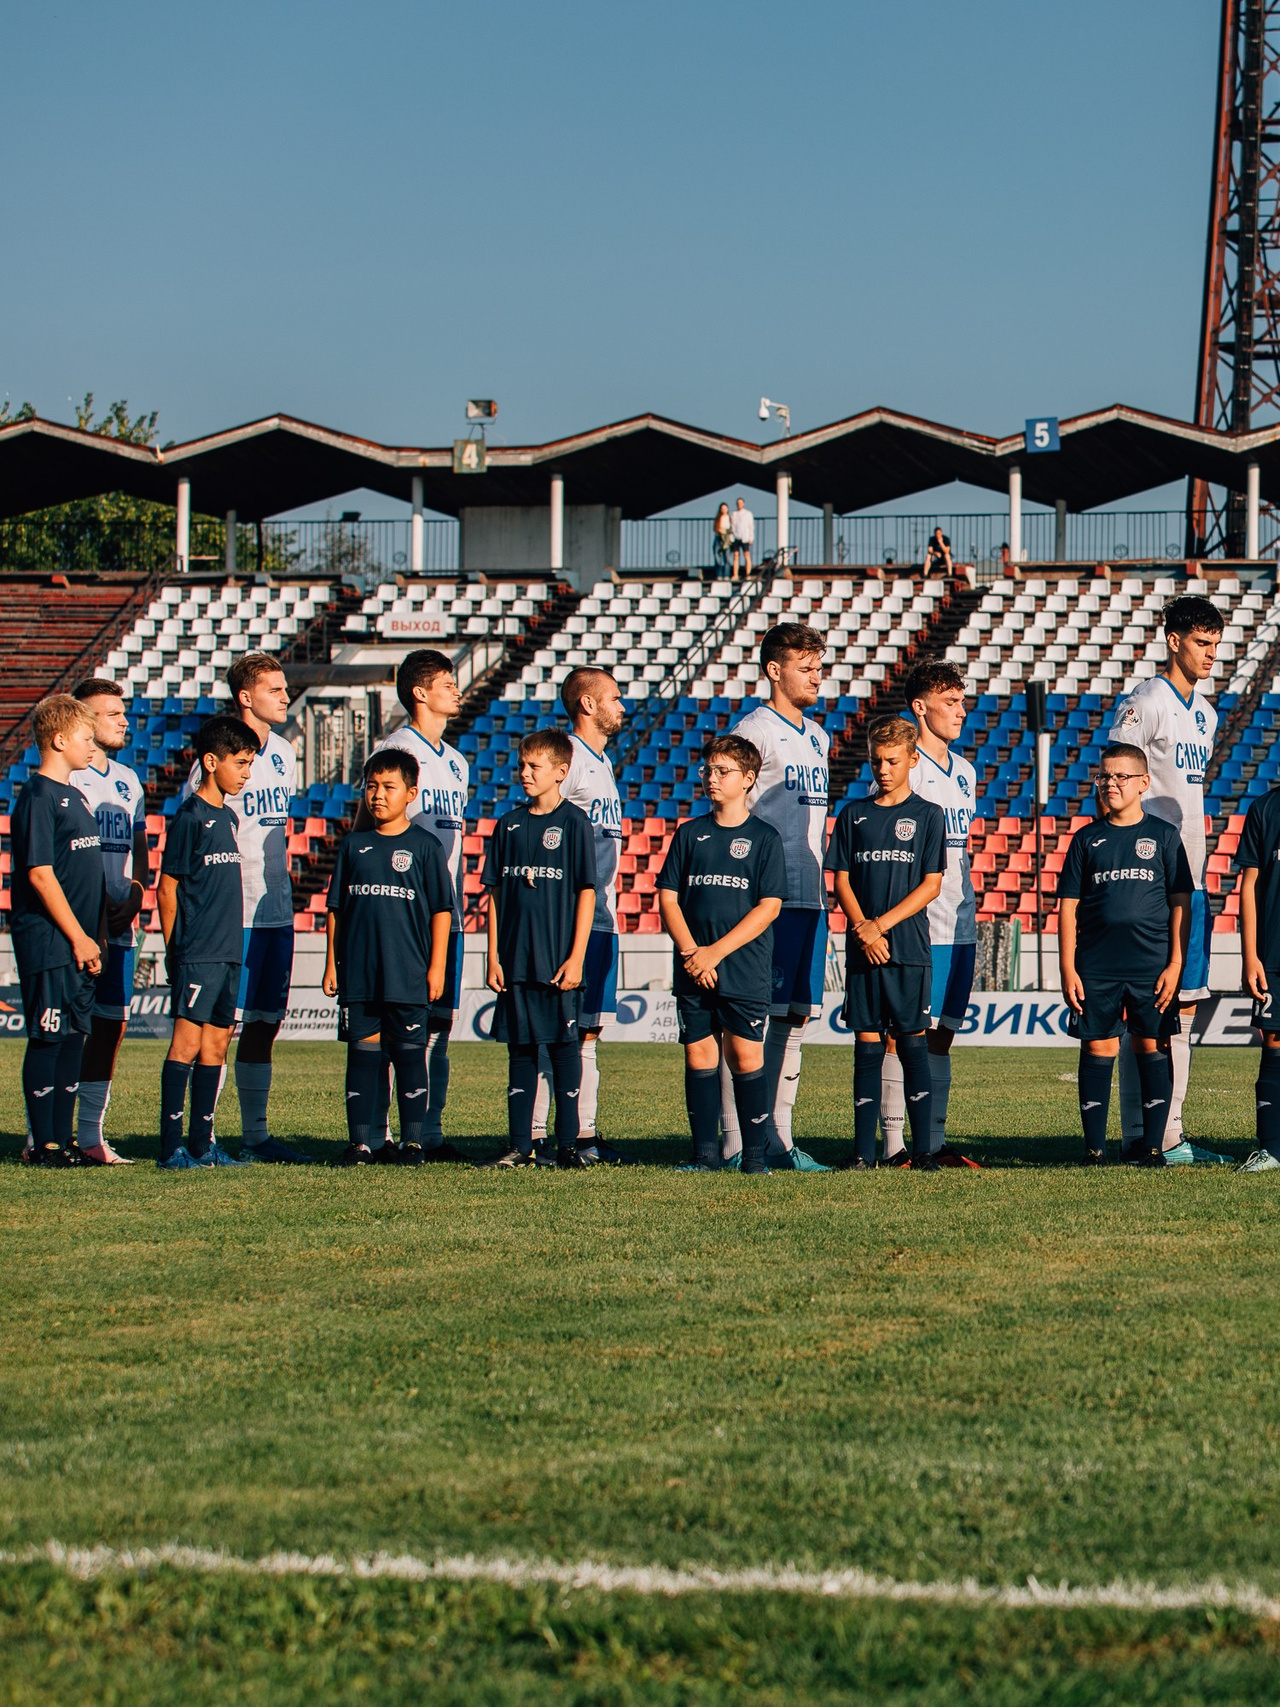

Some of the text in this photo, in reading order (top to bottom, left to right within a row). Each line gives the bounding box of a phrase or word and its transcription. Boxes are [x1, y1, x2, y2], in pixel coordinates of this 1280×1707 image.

[1034, 422, 1050, 448] 5
[462, 443, 479, 469] 4
[391, 621, 441, 632] ВЫХОД
[188, 983, 202, 1008] 7
[40, 1008, 61, 1033] 45
